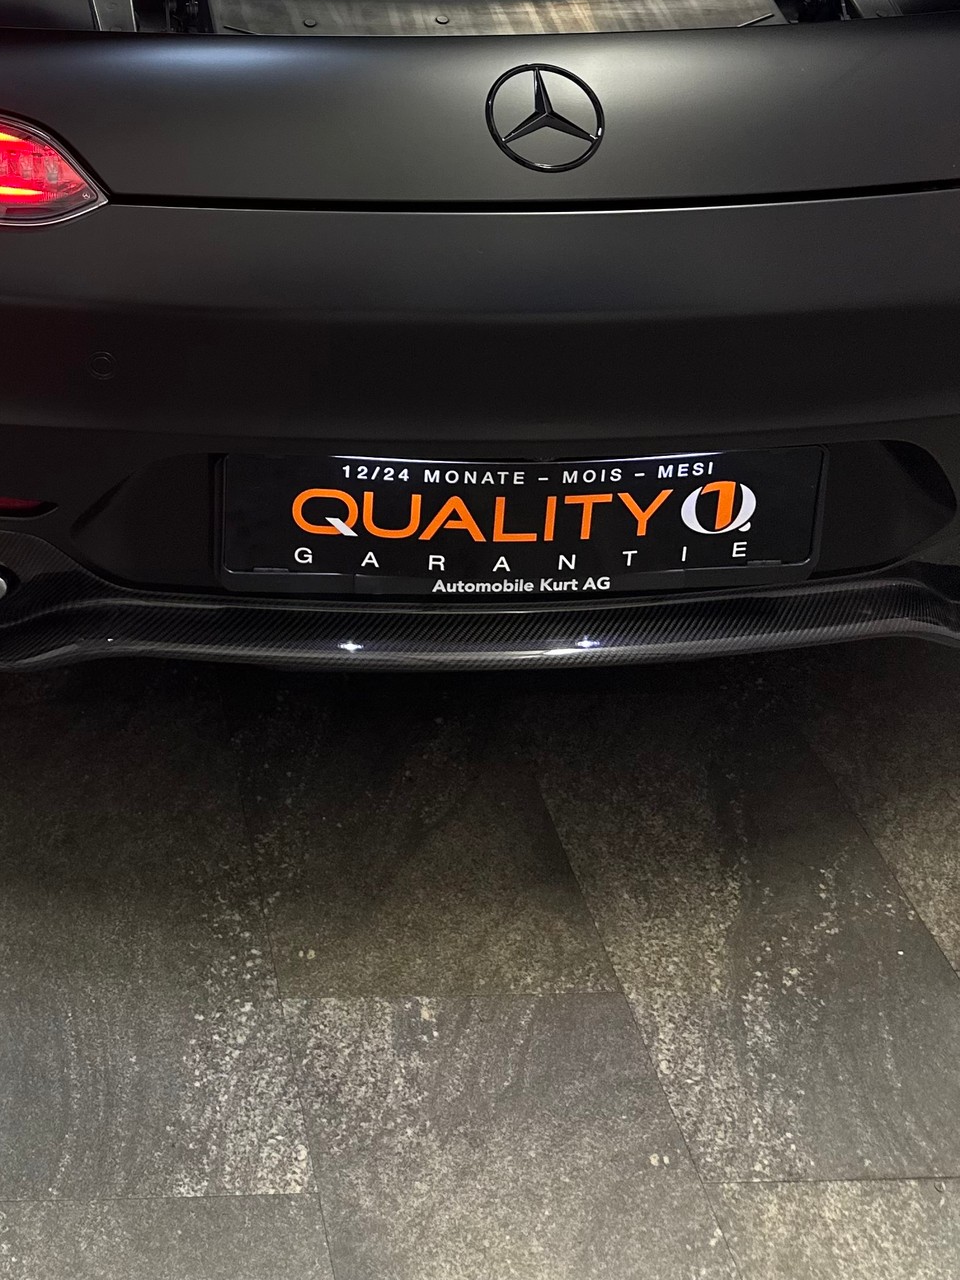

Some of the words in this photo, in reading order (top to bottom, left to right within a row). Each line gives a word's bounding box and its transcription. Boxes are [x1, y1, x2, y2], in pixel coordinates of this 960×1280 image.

[342, 464, 410, 482] 12/24
[423, 469, 525, 485] MONATE
[562, 468, 623, 484] MOIS
[657, 461, 714, 479] MESI
[293, 541, 748, 572] GARANTIE
[432, 579, 534, 593] Automobile
[540, 578, 578, 591] Kurt
[582, 576, 611, 590] AG
